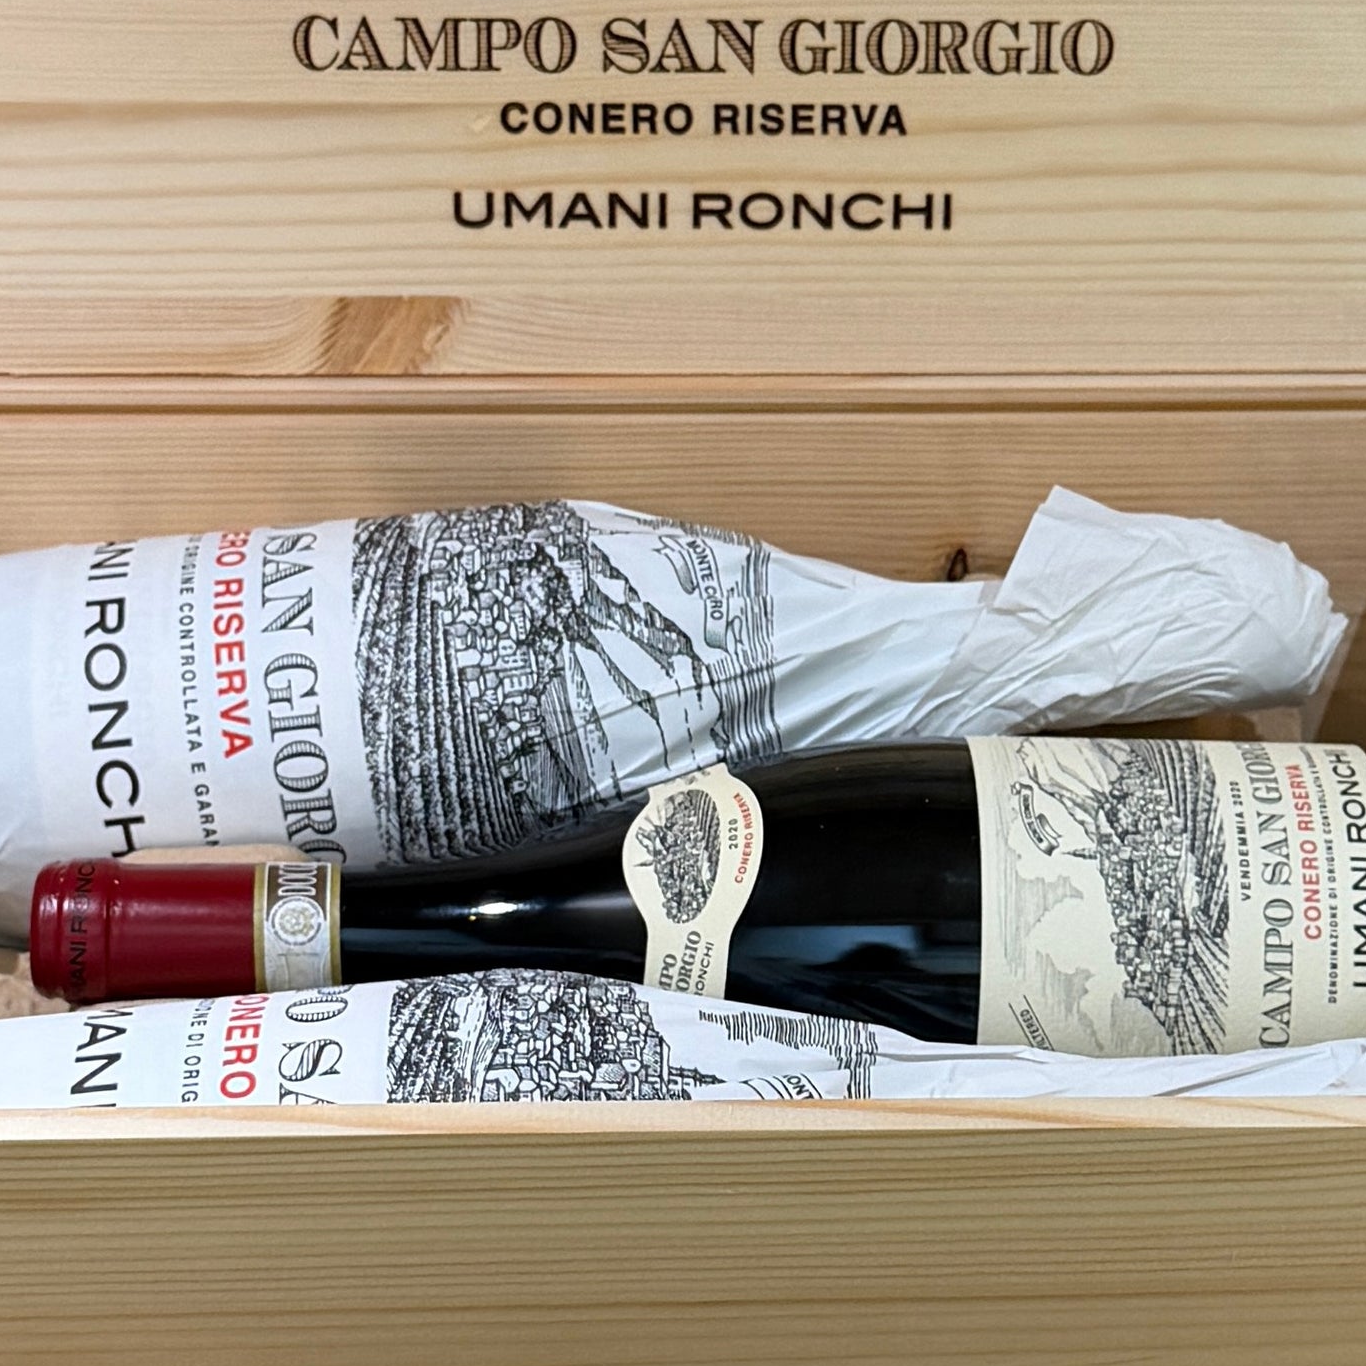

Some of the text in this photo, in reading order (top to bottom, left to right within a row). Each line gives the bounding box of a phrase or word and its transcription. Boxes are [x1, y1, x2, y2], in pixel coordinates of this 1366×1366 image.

[291, 14, 1115, 77] CAMPO SAN GIORGIO
[499, 102, 908, 137] CONERO RISERVA
[452, 191, 954, 232] UMANI RONCHI
[260, 531, 318, 636] SAN
[178, 602, 203, 754] CONTROLLATA
[212, 577, 255, 760] RISERVA
[190, 761, 207, 775] E
[1285, 763, 1316, 832] RISERVA
[1235, 811, 1252, 902] VENDEMMIA
[1256, 810, 1293, 887] SAN
[1299, 839, 1323, 941] CONERO
[1258, 897, 1294, 1049] CAMPO
[1327, 903, 1339, 1004] DENOMINAZIONE
